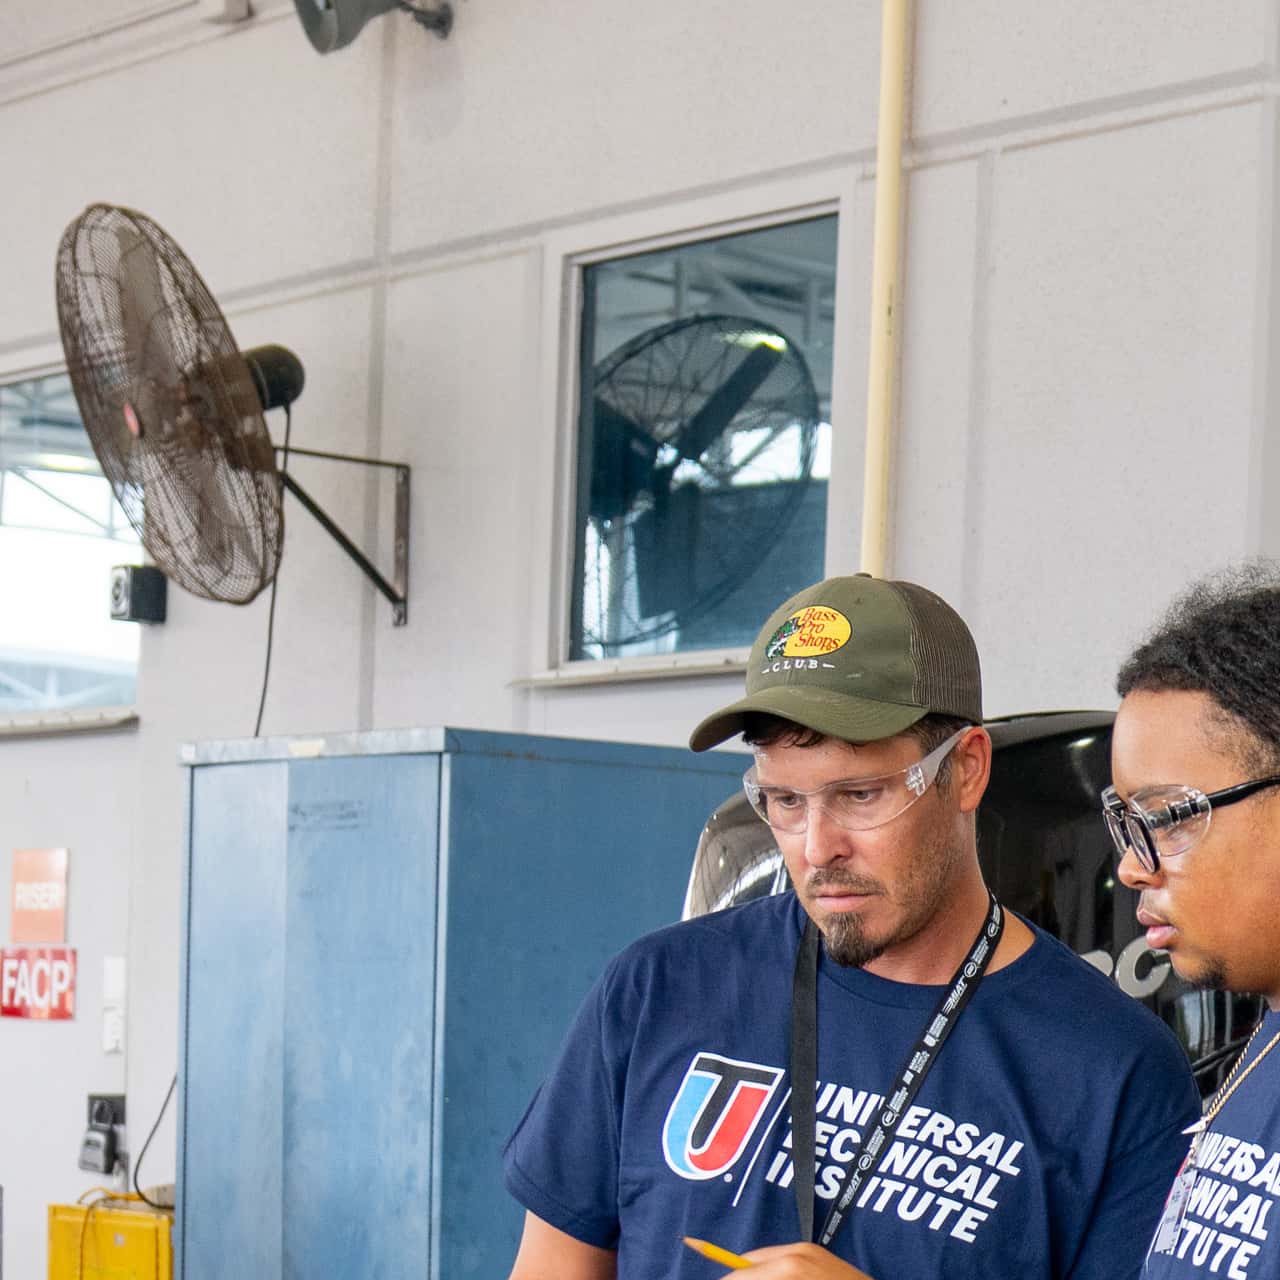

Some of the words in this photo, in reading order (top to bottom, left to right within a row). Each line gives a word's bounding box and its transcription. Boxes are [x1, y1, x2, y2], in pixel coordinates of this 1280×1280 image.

[801, 608, 839, 622] Bass
[799, 620, 825, 634] Pro
[795, 633, 840, 651] Shops
[772, 659, 819, 672] CLUB
[3, 958, 71, 1009] FACP
[815, 1080, 1025, 1176] UNIERSAL
[782, 1115, 1001, 1209] ECNICAL
